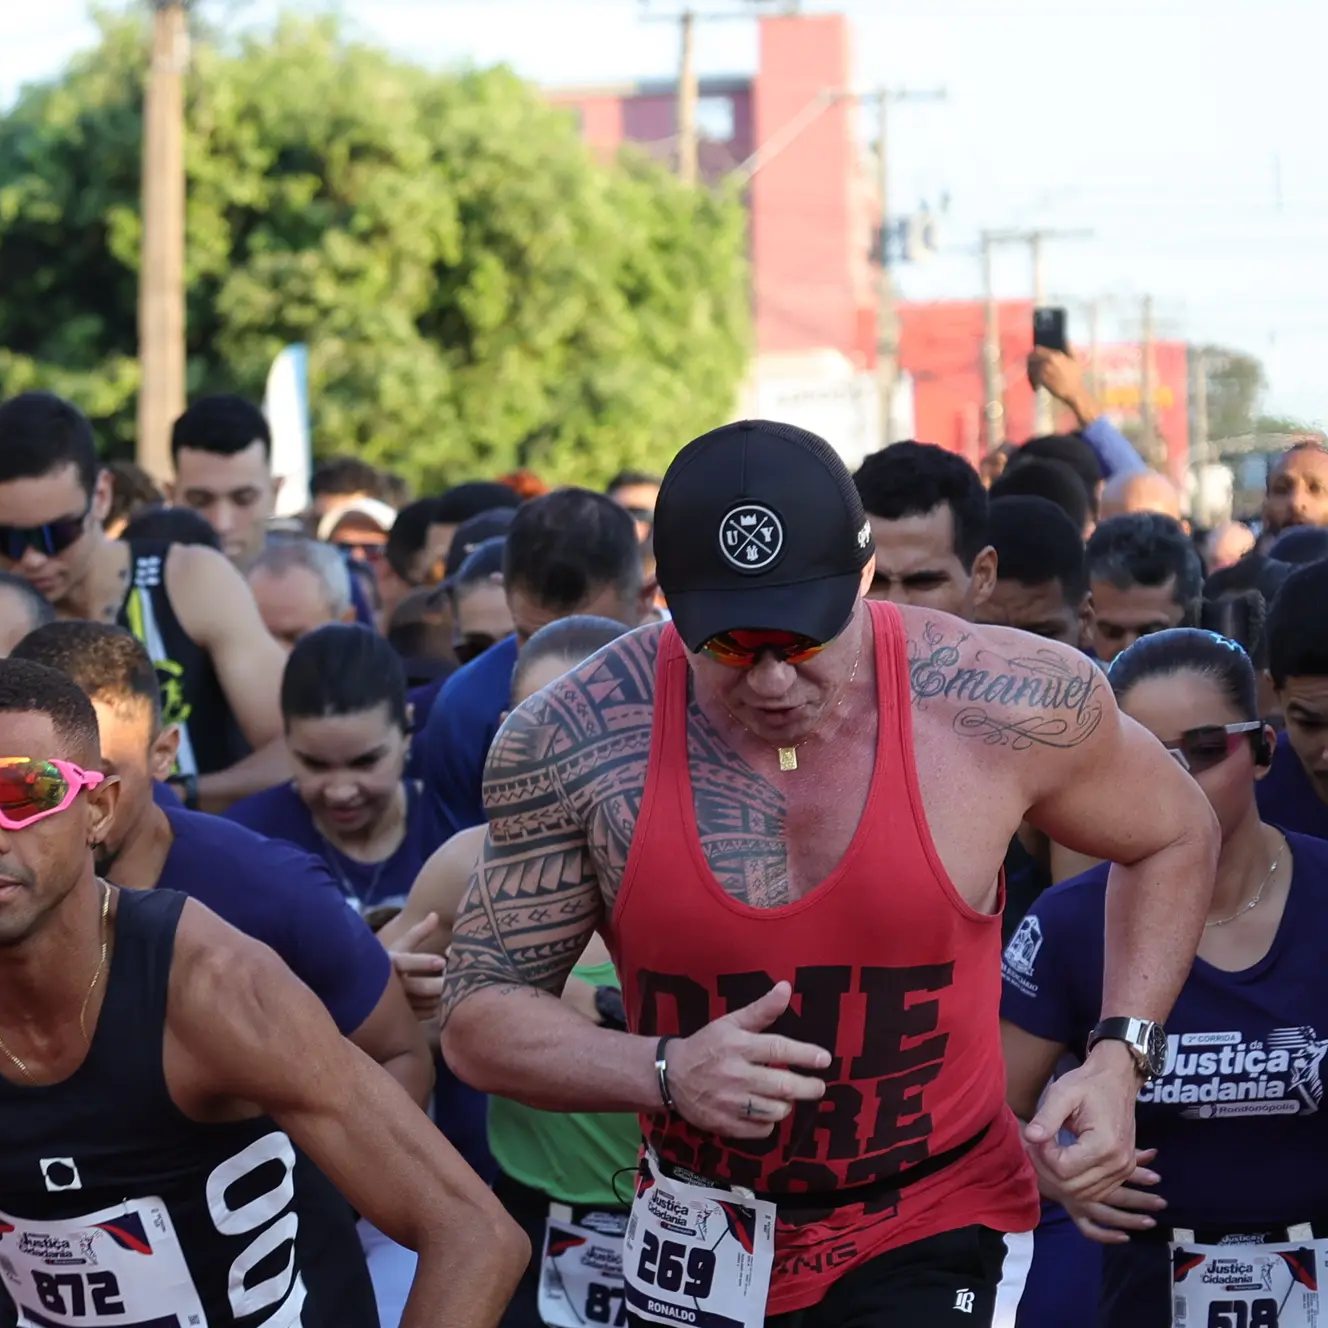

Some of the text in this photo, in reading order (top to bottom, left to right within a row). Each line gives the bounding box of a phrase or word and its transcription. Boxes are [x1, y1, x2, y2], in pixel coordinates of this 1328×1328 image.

[909, 645, 1097, 723] Emanuel
[1198, 1034, 1237, 1043] CORRIDA
[1163, 1034, 1289, 1078] Justiça da
[1136, 1075, 1286, 1104] Cidadania
[1219, 1102, 1296, 1115] Rondonópolis
[648, 1201, 687, 1226] Cidadania
[652, 1188, 689, 1216] Justiça
[637, 1229, 716, 1299] 269
[1207, 1259, 1253, 1273] Justiça
[1202, 1274, 1253, 1284] Cidadania
[31, 1270, 125, 1317] 872
[647, 1300, 696, 1322] RONALDO
